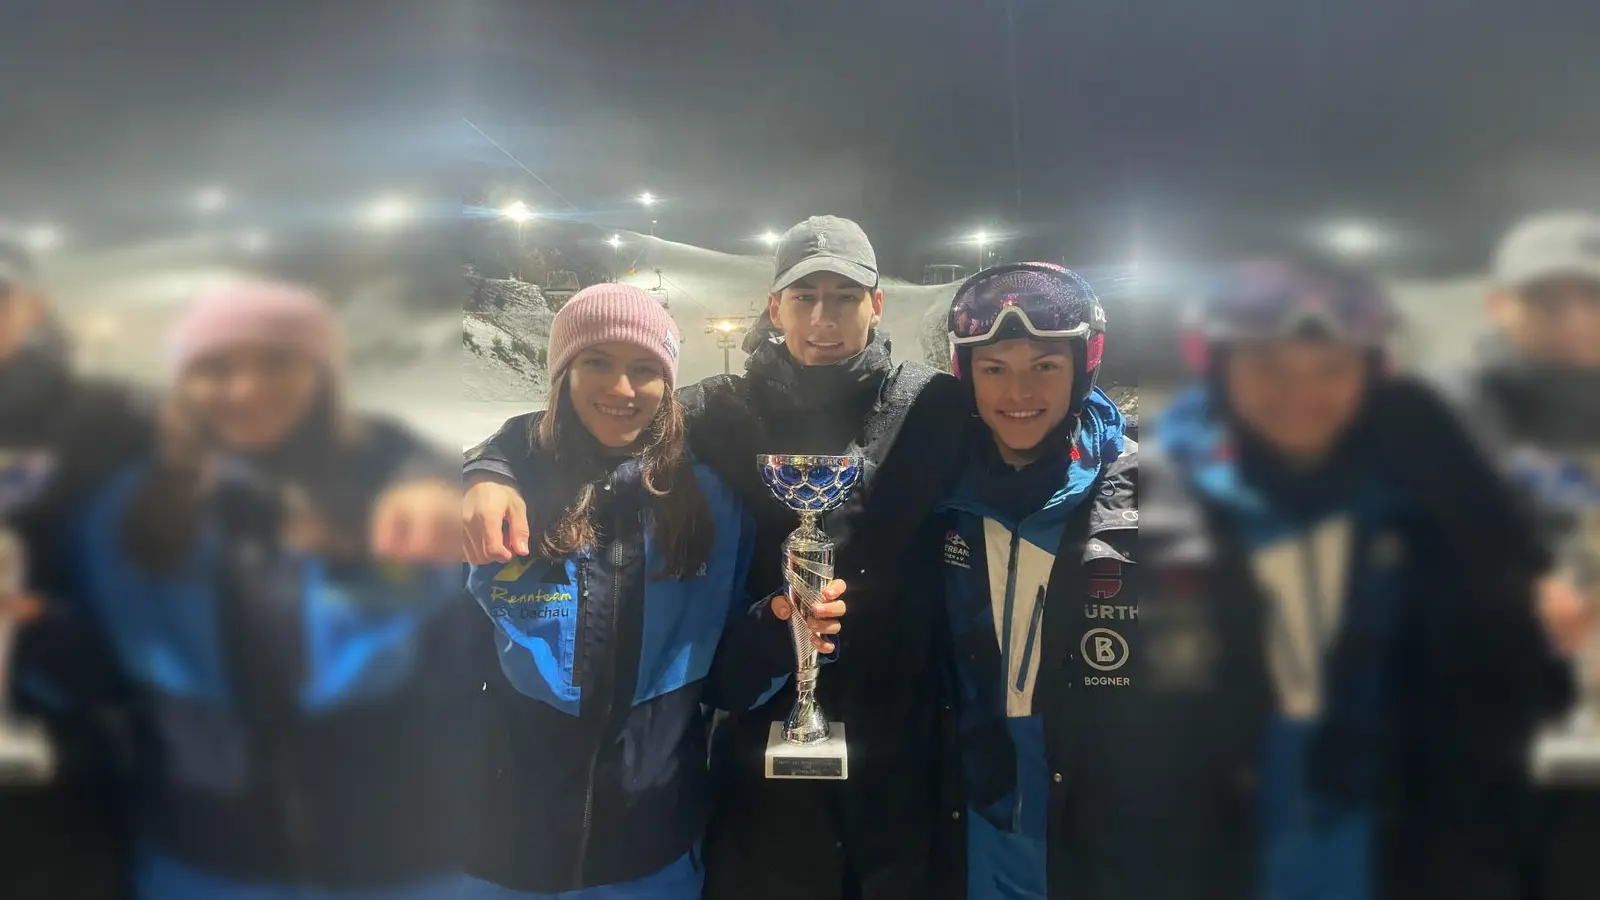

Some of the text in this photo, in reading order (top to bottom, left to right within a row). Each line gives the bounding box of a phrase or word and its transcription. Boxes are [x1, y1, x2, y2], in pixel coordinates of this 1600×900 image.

[491, 586, 572, 604] Rennteam
[521, 606, 569, 619] Dachau
[1095, 636, 1115, 663] B
[1084, 677, 1130, 687] BOGNER
